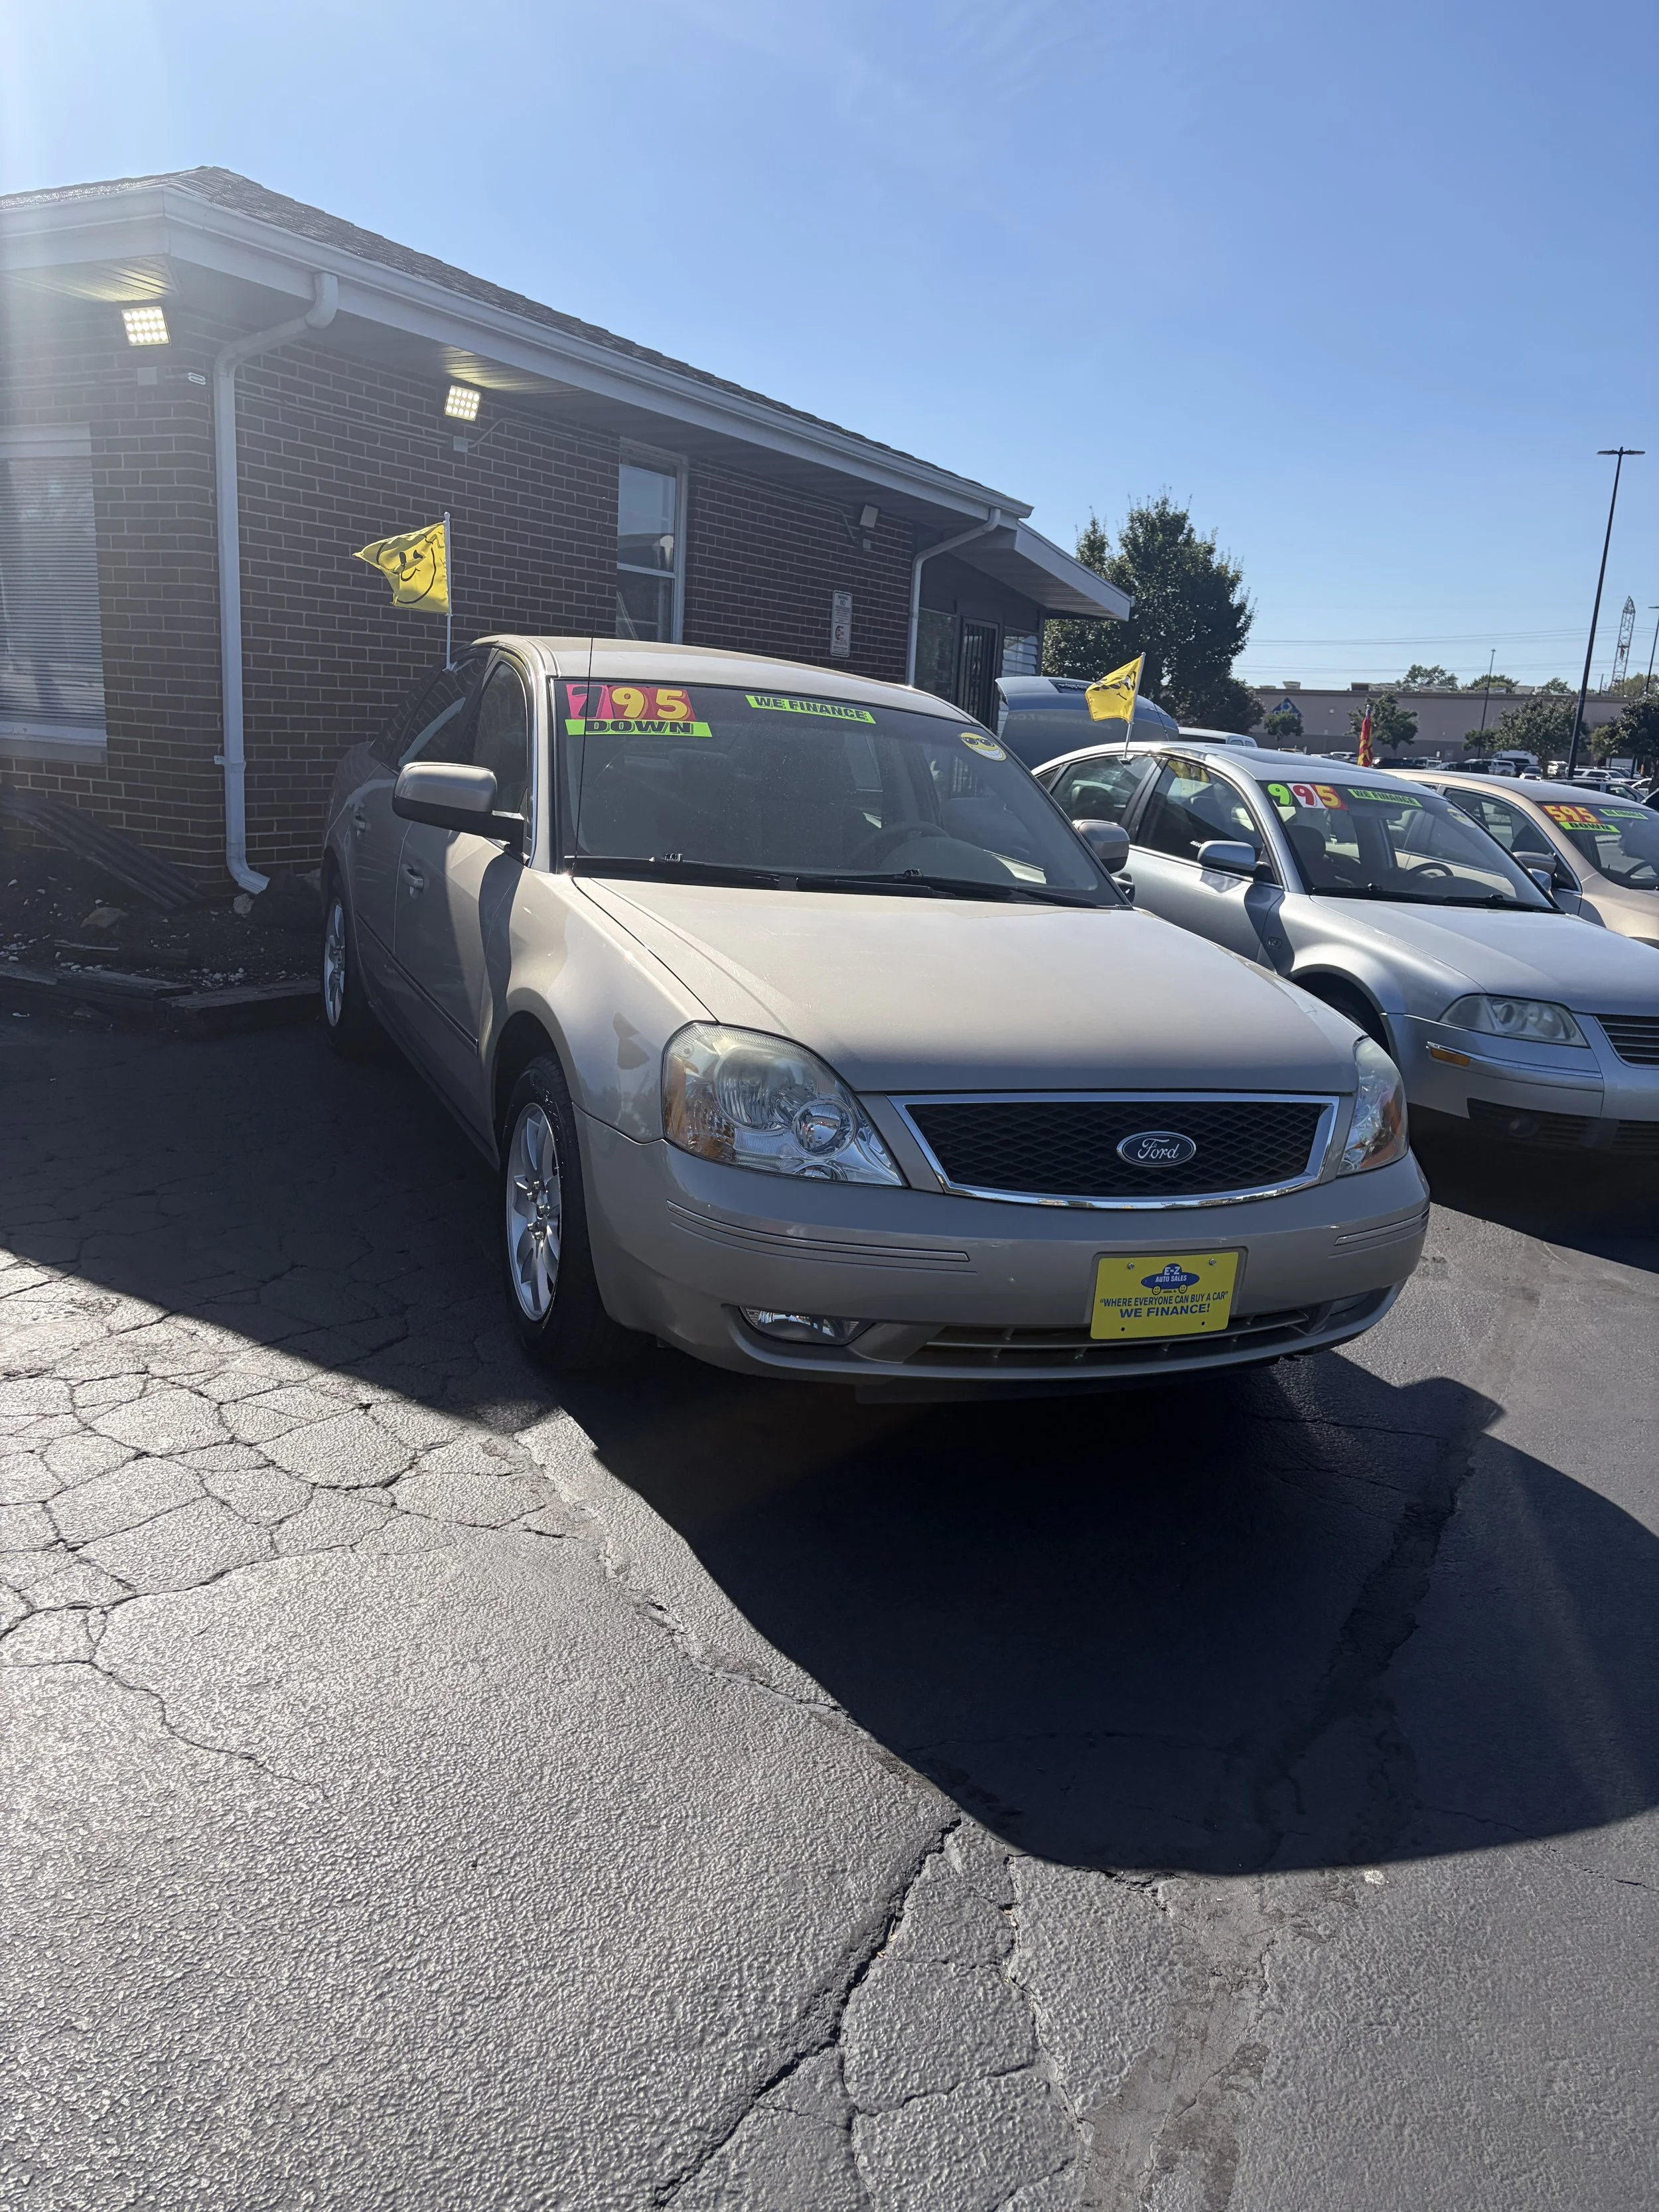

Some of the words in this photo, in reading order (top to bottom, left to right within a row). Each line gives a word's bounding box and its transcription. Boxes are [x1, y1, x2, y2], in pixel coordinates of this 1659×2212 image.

[571, 686, 688, 719] 795
[754, 696, 786, 709] WE
[789, 700, 869, 721] FINANCE
[585, 720, 693, 735] DOWN
[1267, 783, 1340, 809] 995
[1352, 788, 1371, 798] WE
[1544, 805, 1597, 823] 595
[1137, 1138, 1180, 1159] Ford
[1163, 1266, 1181, 1276] E-Z
[1134, 1295, 1173, 1306] EVERYONE
[1175, 1294, 1189, 1303] CAN
[1190, 1293, 1204, 1302] BUY
[1119, 1307, 1143, 1318] WE
[1146, 1303, 1210, 1317] FINANCE!
